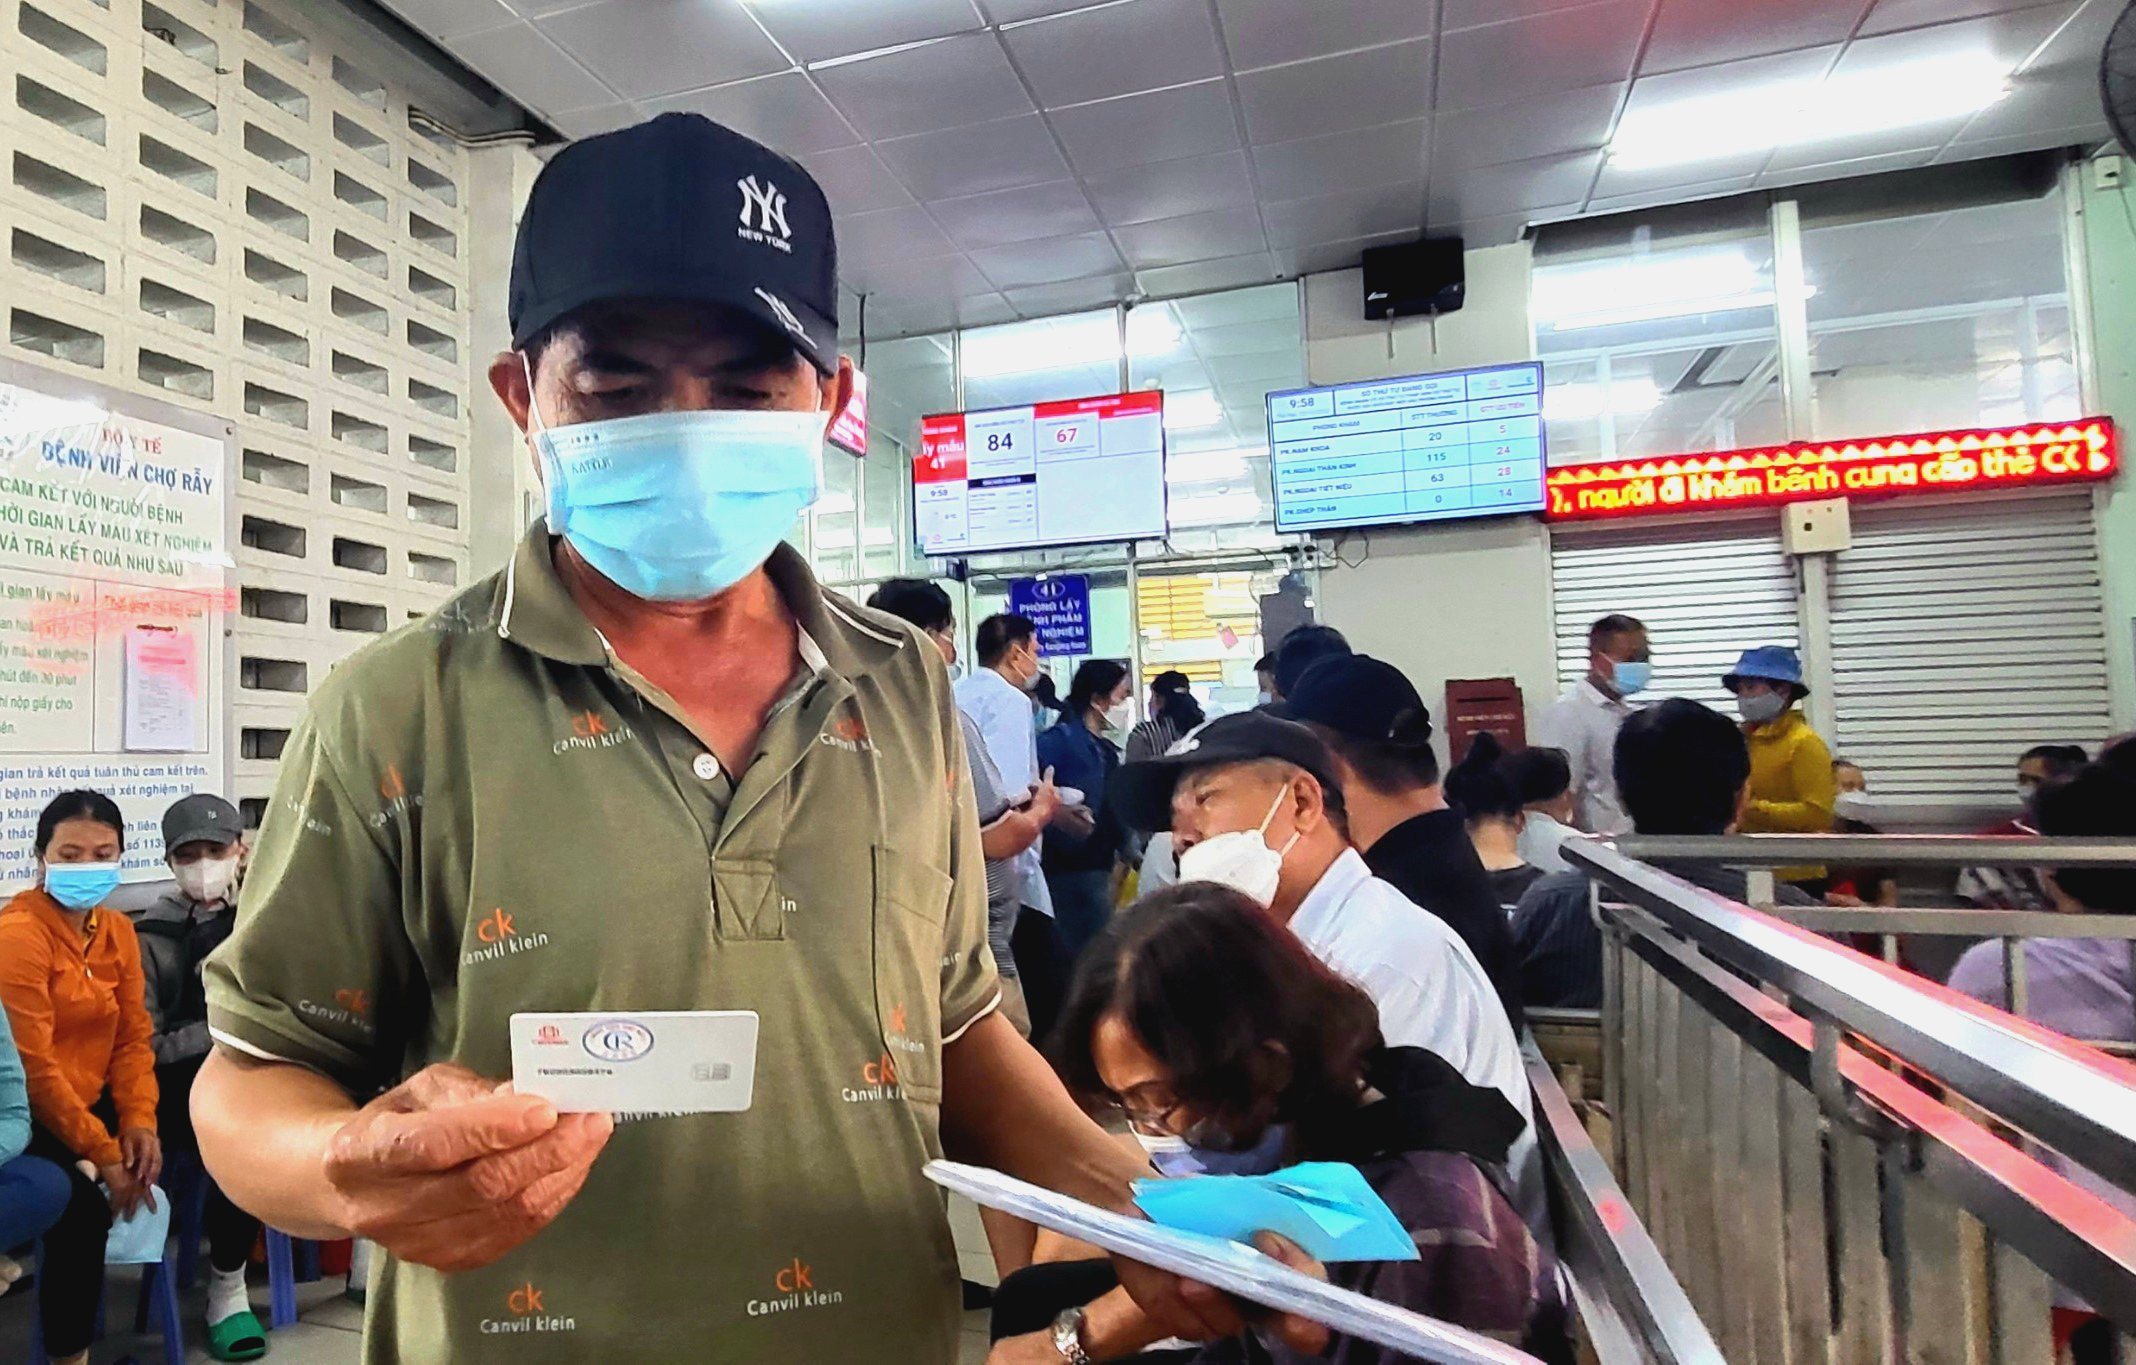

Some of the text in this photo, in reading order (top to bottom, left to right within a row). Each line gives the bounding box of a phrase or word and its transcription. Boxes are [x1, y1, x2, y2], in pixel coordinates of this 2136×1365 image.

[737, 174, 792, 239] NY
[738, 226, 792, 254] NEW YORK
[1289, 397, 1315, 409] 9:58
[1056, 428, 1077, 443] 67
[1428, 431, 1442, 441] 20
[1499, 424, 1506, 433] 5
[988, 433, 1014, 451] 84
[1497, 446, 1510, 455] 24
[1427, 452, 1446, 462] 115
[144, 464, 176, 490] CHỢ
[182, 467, 212, 495] RẪY
[1431, 473, 1444, 482] 63
[0, 476, 33, 497] CAM
[147, 503, 183, 525] BỆNH
[1435, 495, 1442, 503] 0
[0, 502, 23, 524] HỜI
[28, 510, 64, 531] GIAN
[60, 539, 88, 562] KẾT
[93, 547, 122, 569] QUẢ
[158, 558, 184, 577] SAU
[55, 698, 73, 710] cho
[48, 764, 66, 778] kết
[143, 766, 164, 776] cam
[139, 783, 178, 797] nghiệm
[478, 906, 516, 942] ck
[460, 932, 548, 966] anvil klein
[299, 999, 349, 1022] Canvil
[842, 1085, 882, 1102] Canvil
[775, 1258, 814, 1294] ck
[508, 1281, 543, 1315] ck
[746, 1289, 843, 1317] Canvil klein
[480, 1315, 576, 1335] Canvil klein
